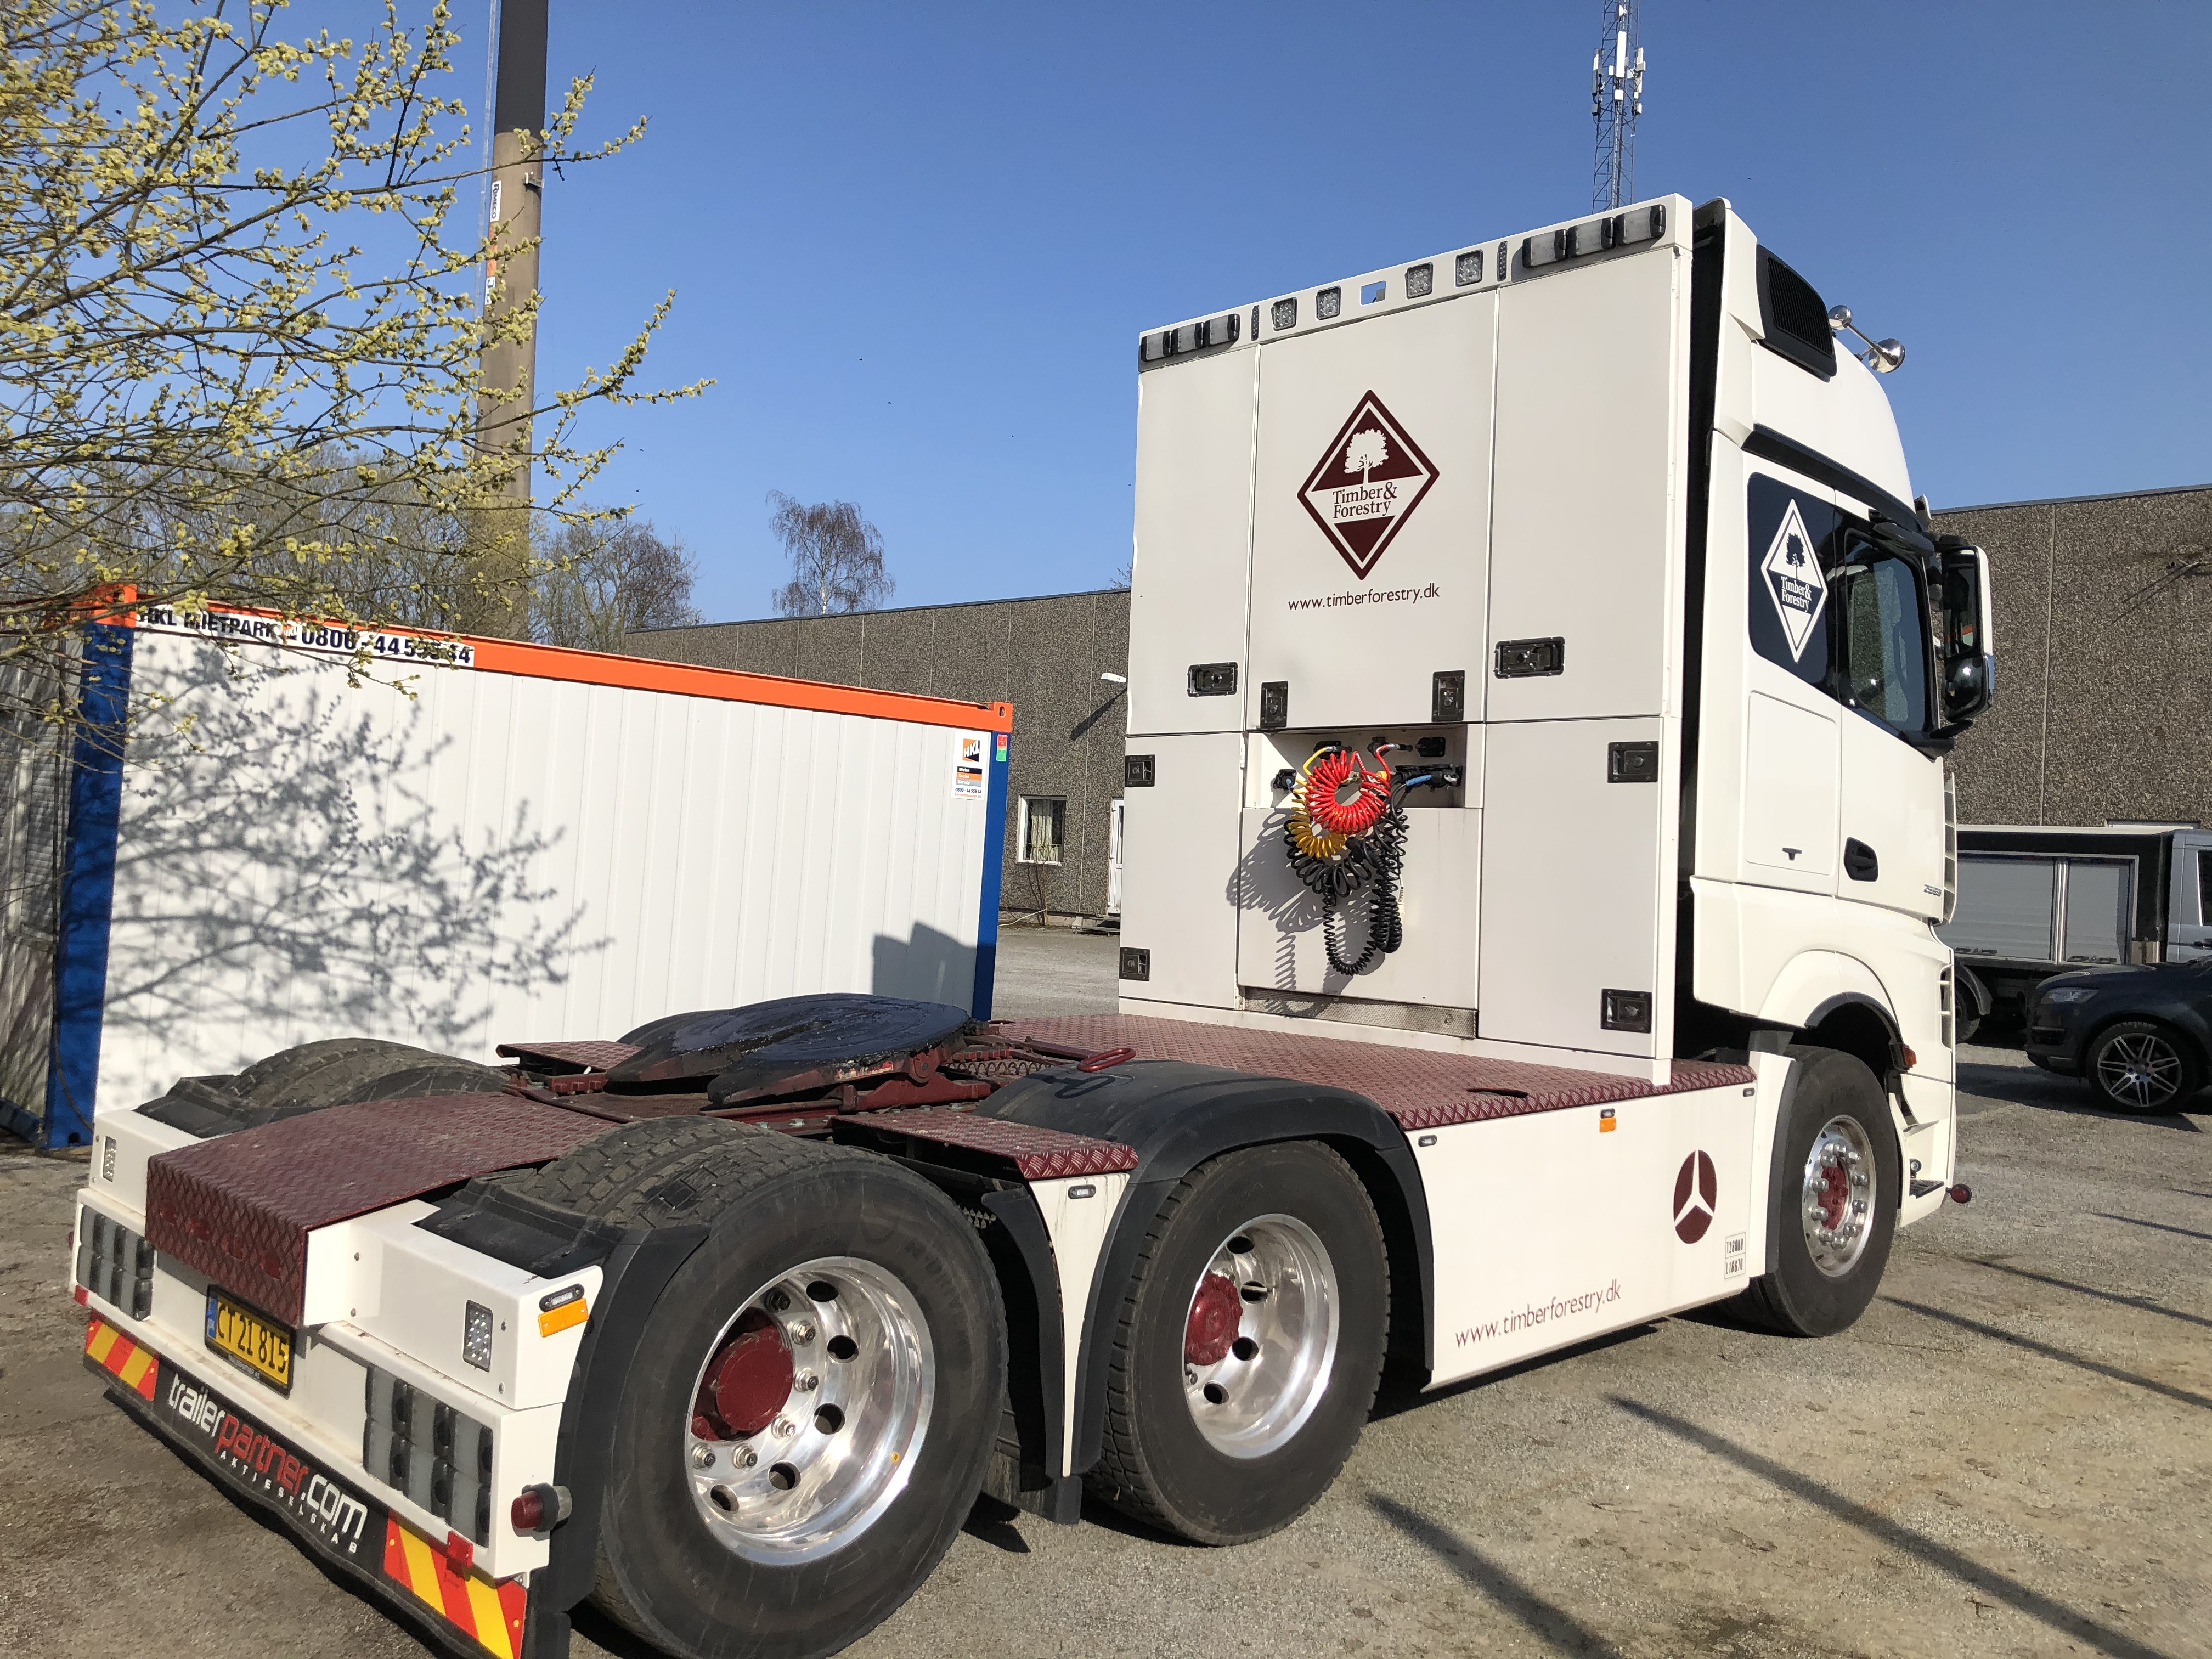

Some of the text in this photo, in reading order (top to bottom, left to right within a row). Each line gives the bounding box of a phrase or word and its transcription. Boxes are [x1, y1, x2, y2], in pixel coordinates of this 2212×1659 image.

[1333, 482, 1397, 505] Timber&
[1333, 500, 1391, 518] Forestry
[1288, 583, 1440, 611] www.timberforestry.dk
[1781, 576, 1812, 601] Timber&
[1781, 589, 1809, 613] Forestry
[964, 740, 980, 757] HKL
[1455, 1279, 1621, 1347] www.timberforestry.dk
[218, 1303, 236, 1343] CT
[238, 1314, 253, 1356] 21
[258, 1326, 287, 1374] 815
[168, 1373, 368, 1539] trailerpartner.com
